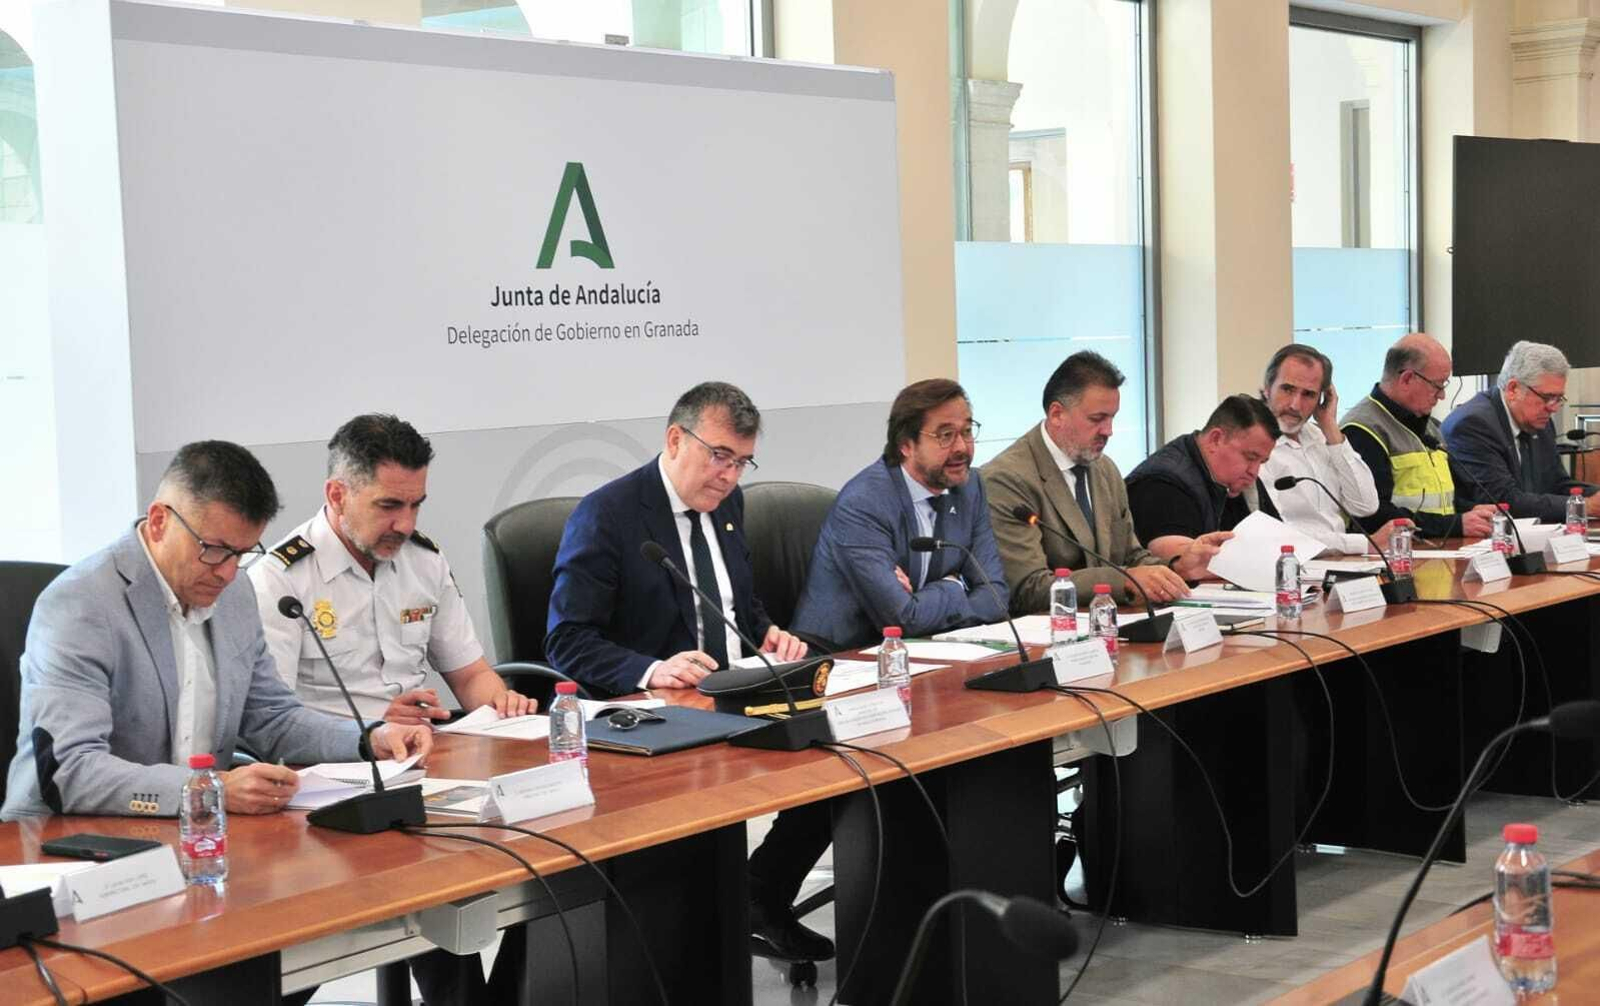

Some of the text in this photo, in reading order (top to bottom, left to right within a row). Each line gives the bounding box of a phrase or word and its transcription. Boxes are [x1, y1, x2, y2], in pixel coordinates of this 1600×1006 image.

[490, 280, 662, 307] Junta de Andalucía
[447, 319, 700, 349] Delegación de Gobierno en Granada
